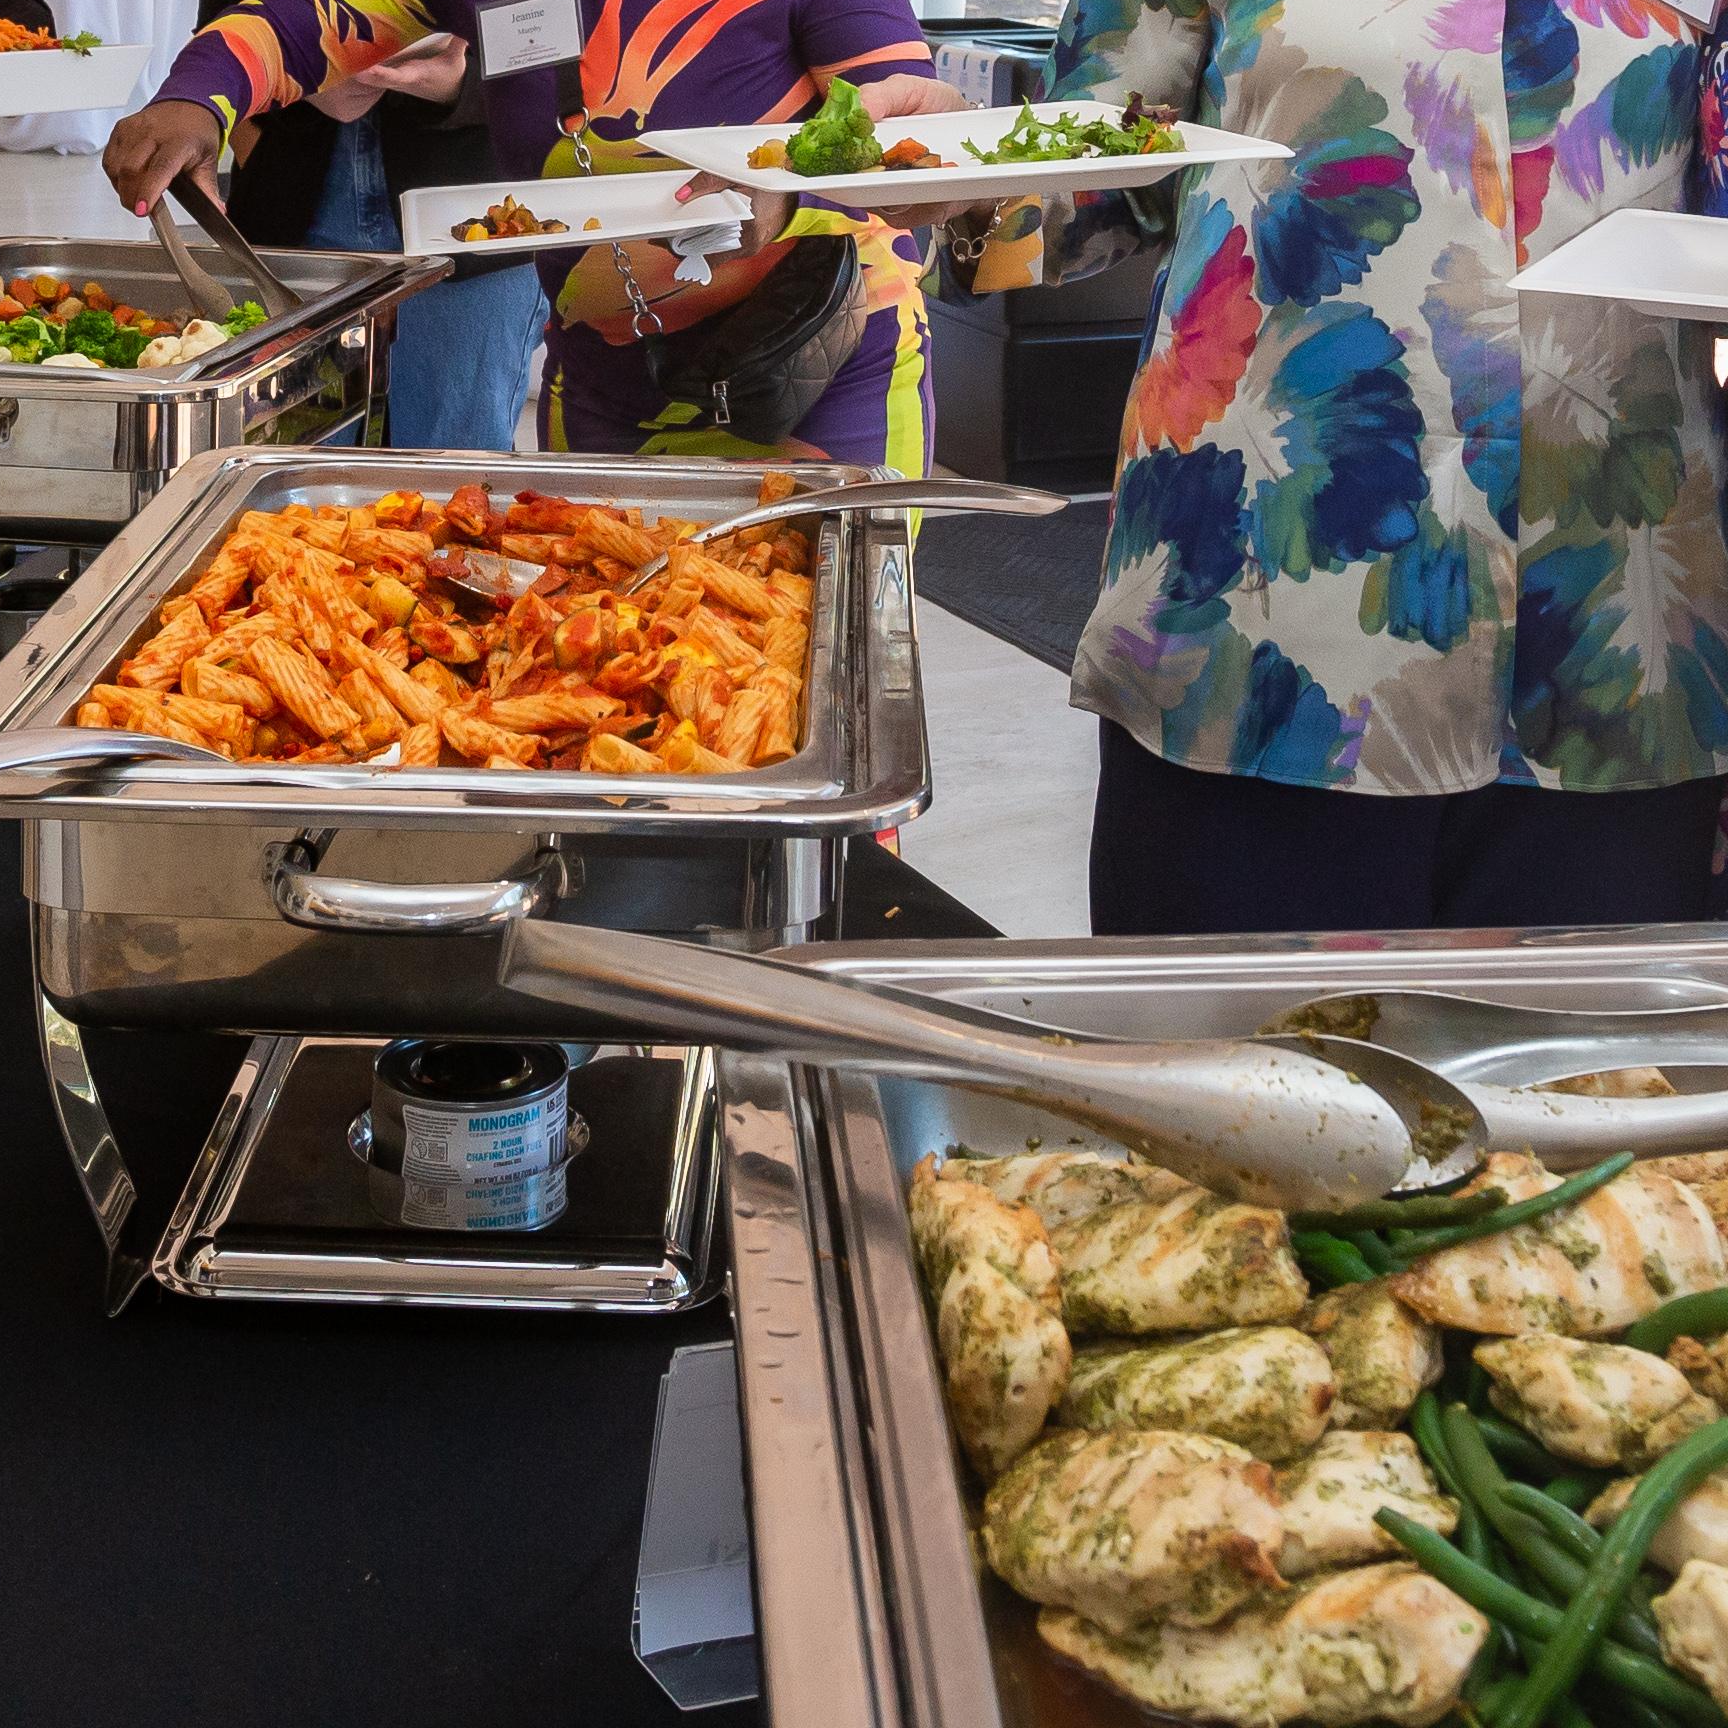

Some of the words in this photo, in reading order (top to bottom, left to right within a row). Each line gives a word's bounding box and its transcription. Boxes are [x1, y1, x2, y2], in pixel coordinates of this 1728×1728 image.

[512, 9, 545, 23] Jeanine
[468, 1106, 541, 1132] MONOGRAM
[493, 1141, 500, 1150] 2
[501, 1136, 522, 1148] HOUR
[466, 1151, 503, 1162] CHAFING
[506, 1146, 525, 1158] DISH
